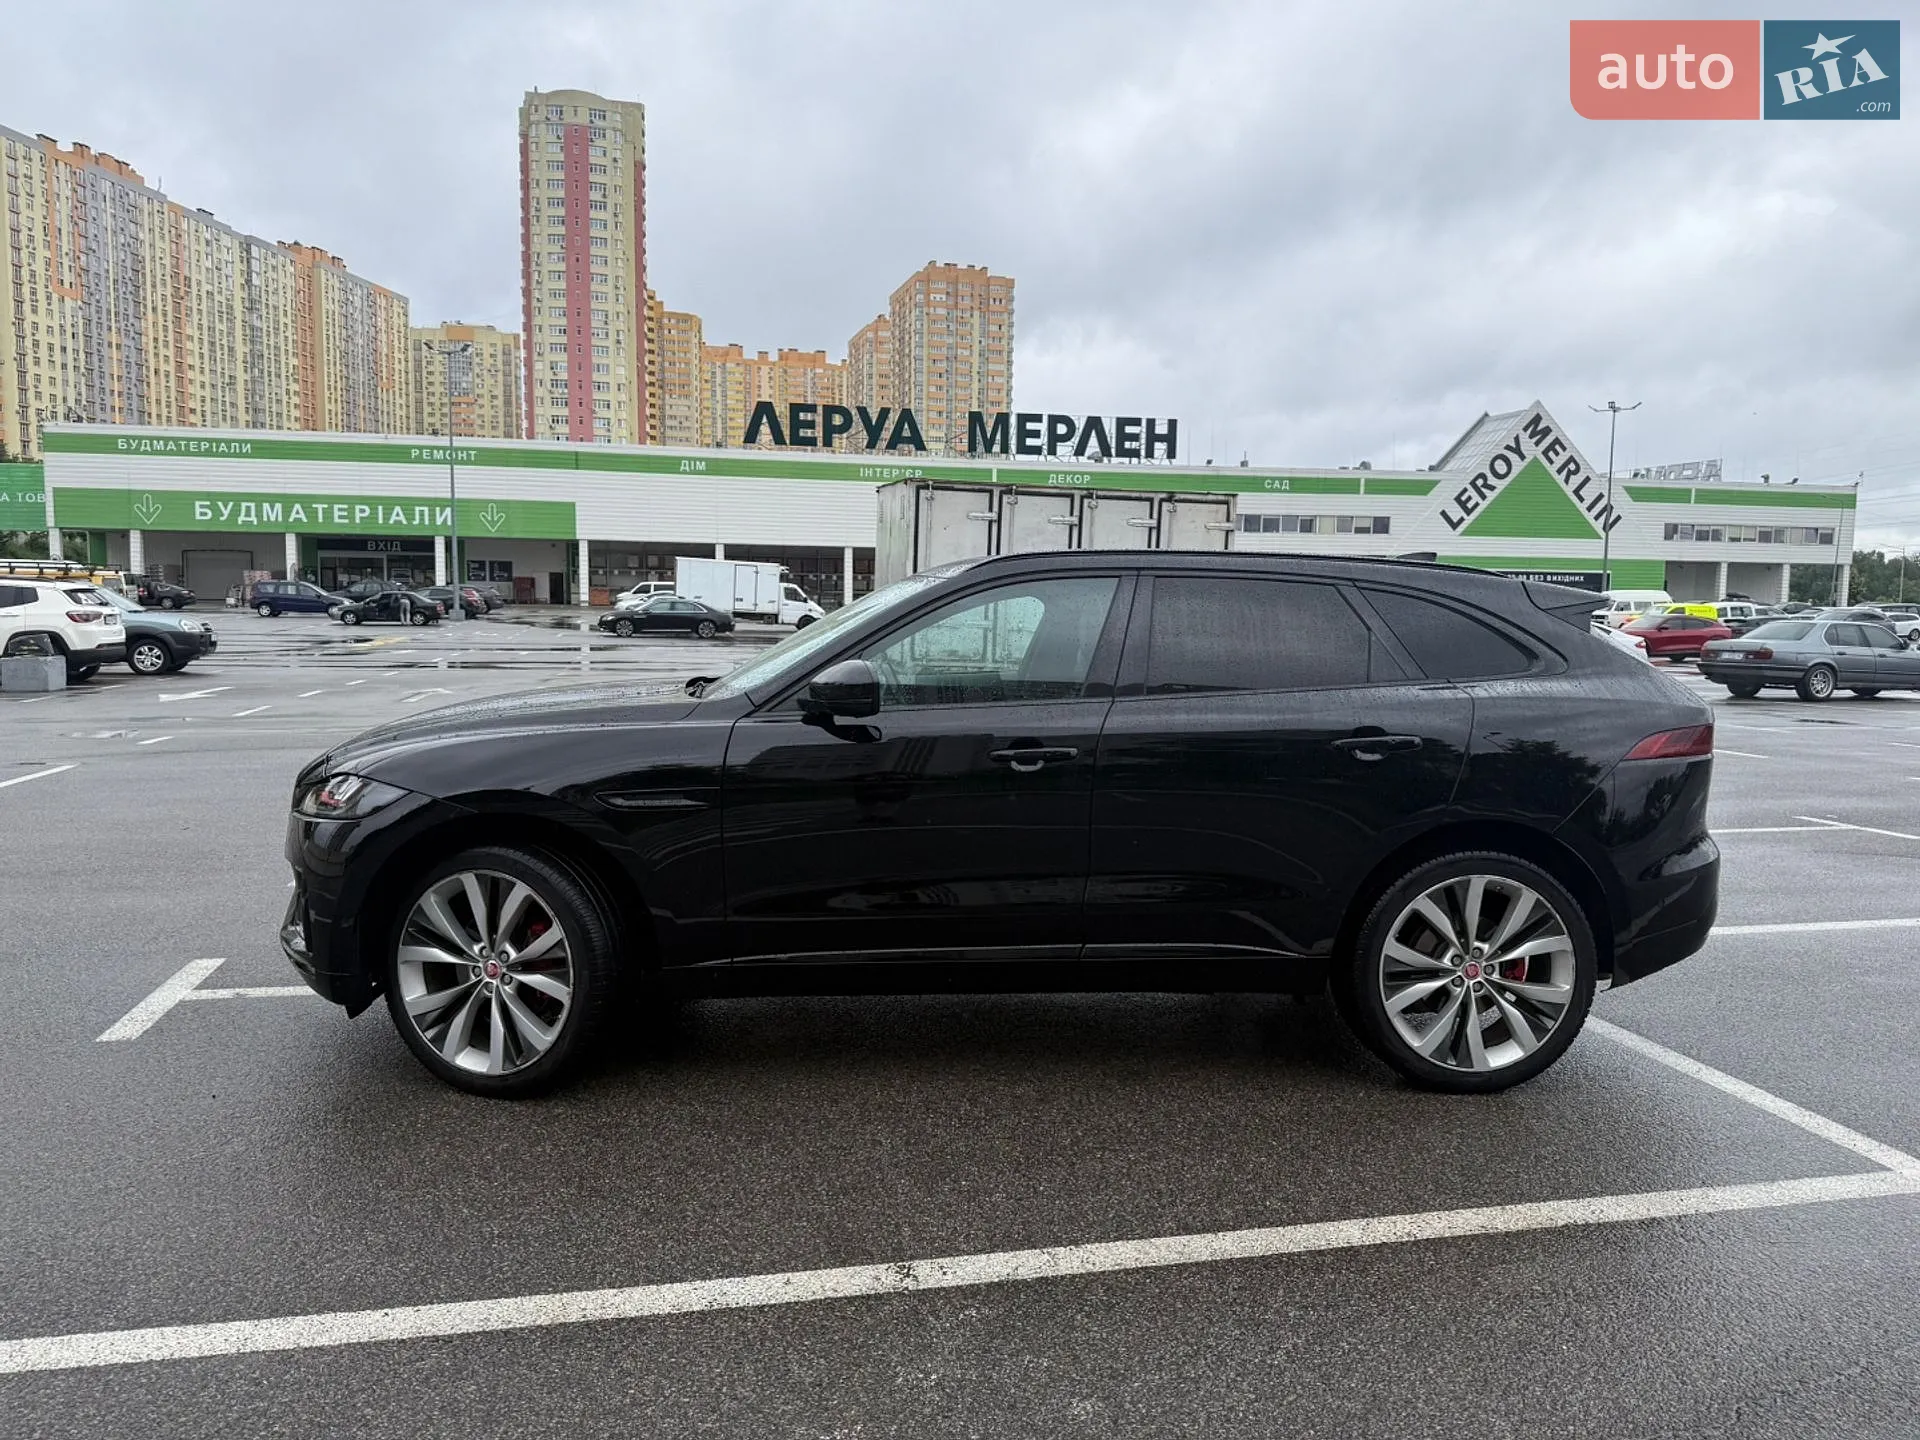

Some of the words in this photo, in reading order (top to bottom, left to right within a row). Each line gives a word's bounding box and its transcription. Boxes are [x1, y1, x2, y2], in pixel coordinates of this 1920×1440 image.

[743, 401, 927, 451] ЛЕРУА
[968, 411, 1178, 459] МЕРЛЕН
[117, 438, 252, 453] БУДМАТЕРІАЛИ
[411, 448, 477, 461] РЕМОНТ
[680, 460, 706, 472] ДІМ
[1439, 434, 1527, 532] LEROY
[1522, 412, 1622, 534] MERLIN
[1048, 474, 1091, 486] ДЕКОР
[1264, 479, 1290, 491] САД
[194, 500, 453, 526] БУДМАТЕРІАЛИ
[367, 540, 401, 552] ВХІД
